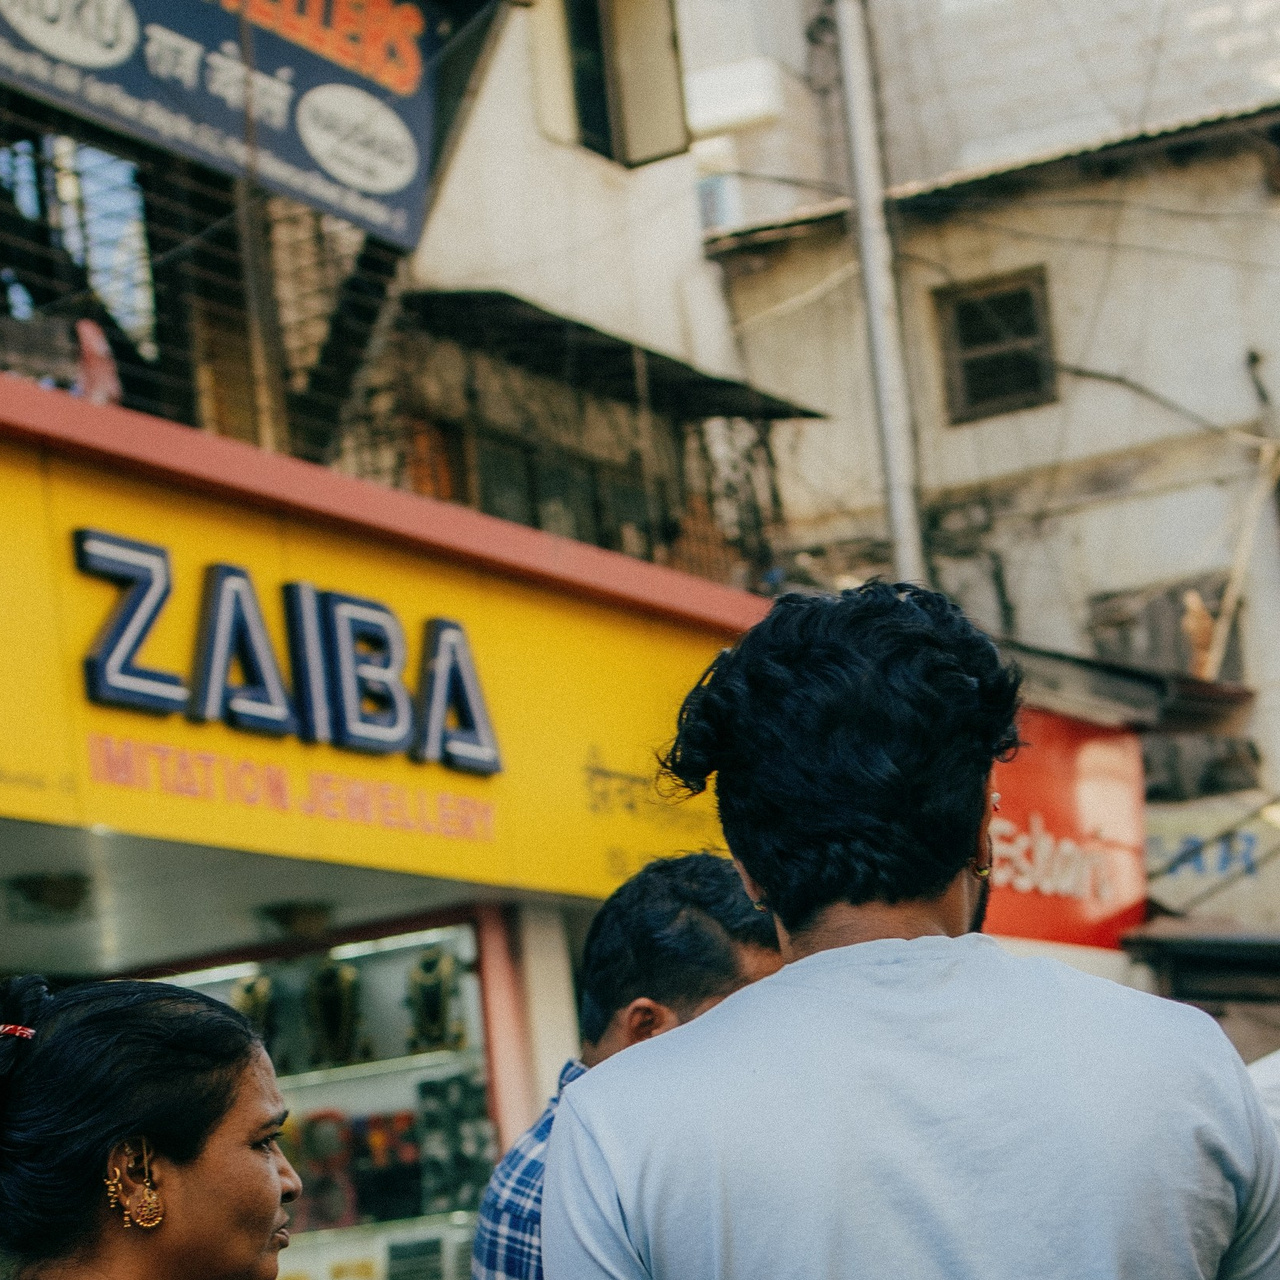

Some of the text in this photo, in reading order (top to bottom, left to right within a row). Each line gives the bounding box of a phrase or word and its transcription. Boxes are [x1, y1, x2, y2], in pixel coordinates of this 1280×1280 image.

[74, 529, 502, 775] ZAIBA
[87, 731, 290, 812] IMITATION
[301, 770, 497, 843] JEWELLERY
